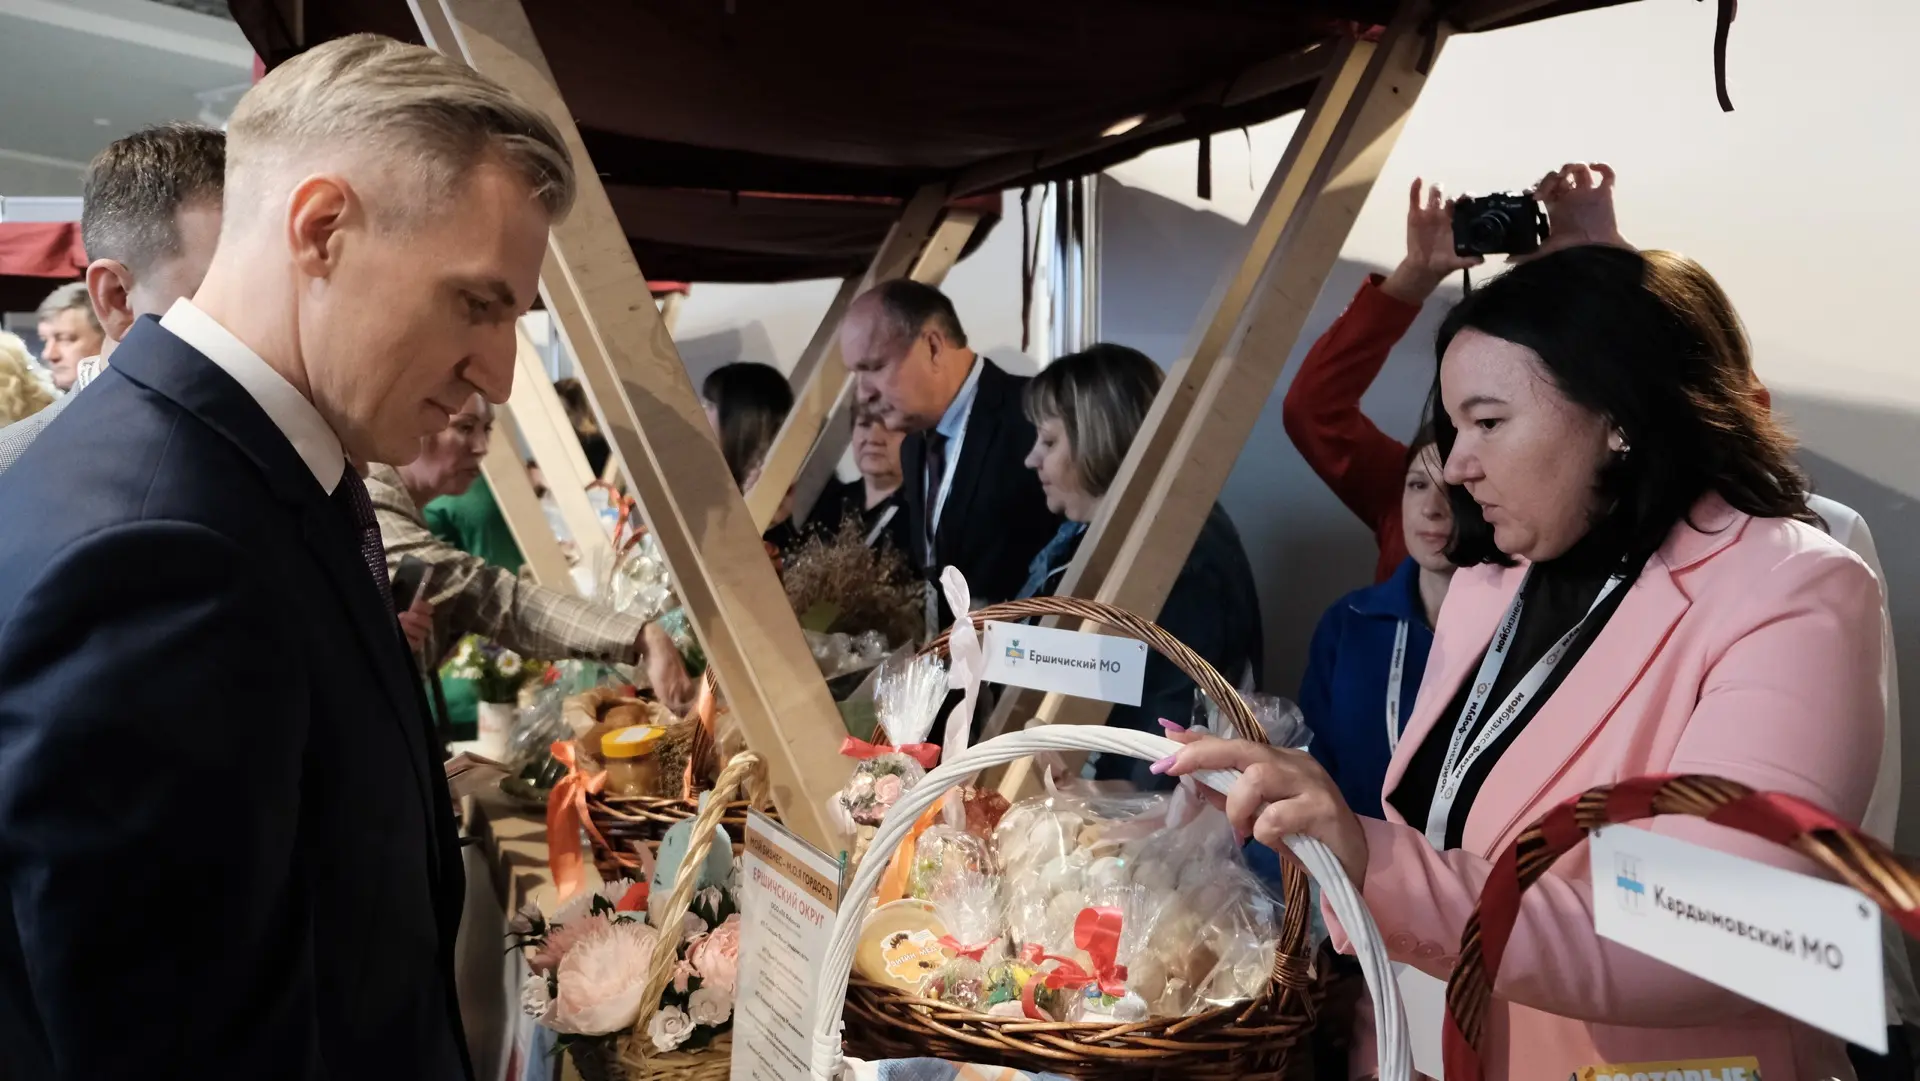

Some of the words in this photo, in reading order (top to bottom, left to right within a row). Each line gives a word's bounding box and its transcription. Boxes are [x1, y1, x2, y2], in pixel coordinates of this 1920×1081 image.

[1029, 649, 1097, 671] Ершичиский
[1099, 659, 1121, 674] МО
[1455, 691, 1526, 780] мойбизнес.форум
[753, 866, 798, 911] ЕРШИЧСКИЙ
[799, 899, 825, 930] ОКРУГ
[763, 844, 783, 868] БИЗНЕС
[802, 871, 833, 901] ГОРДОСТЬ
[1654, 884, 1796, 956] Кардымовский
[1800, 933, 1845, 971] МО
